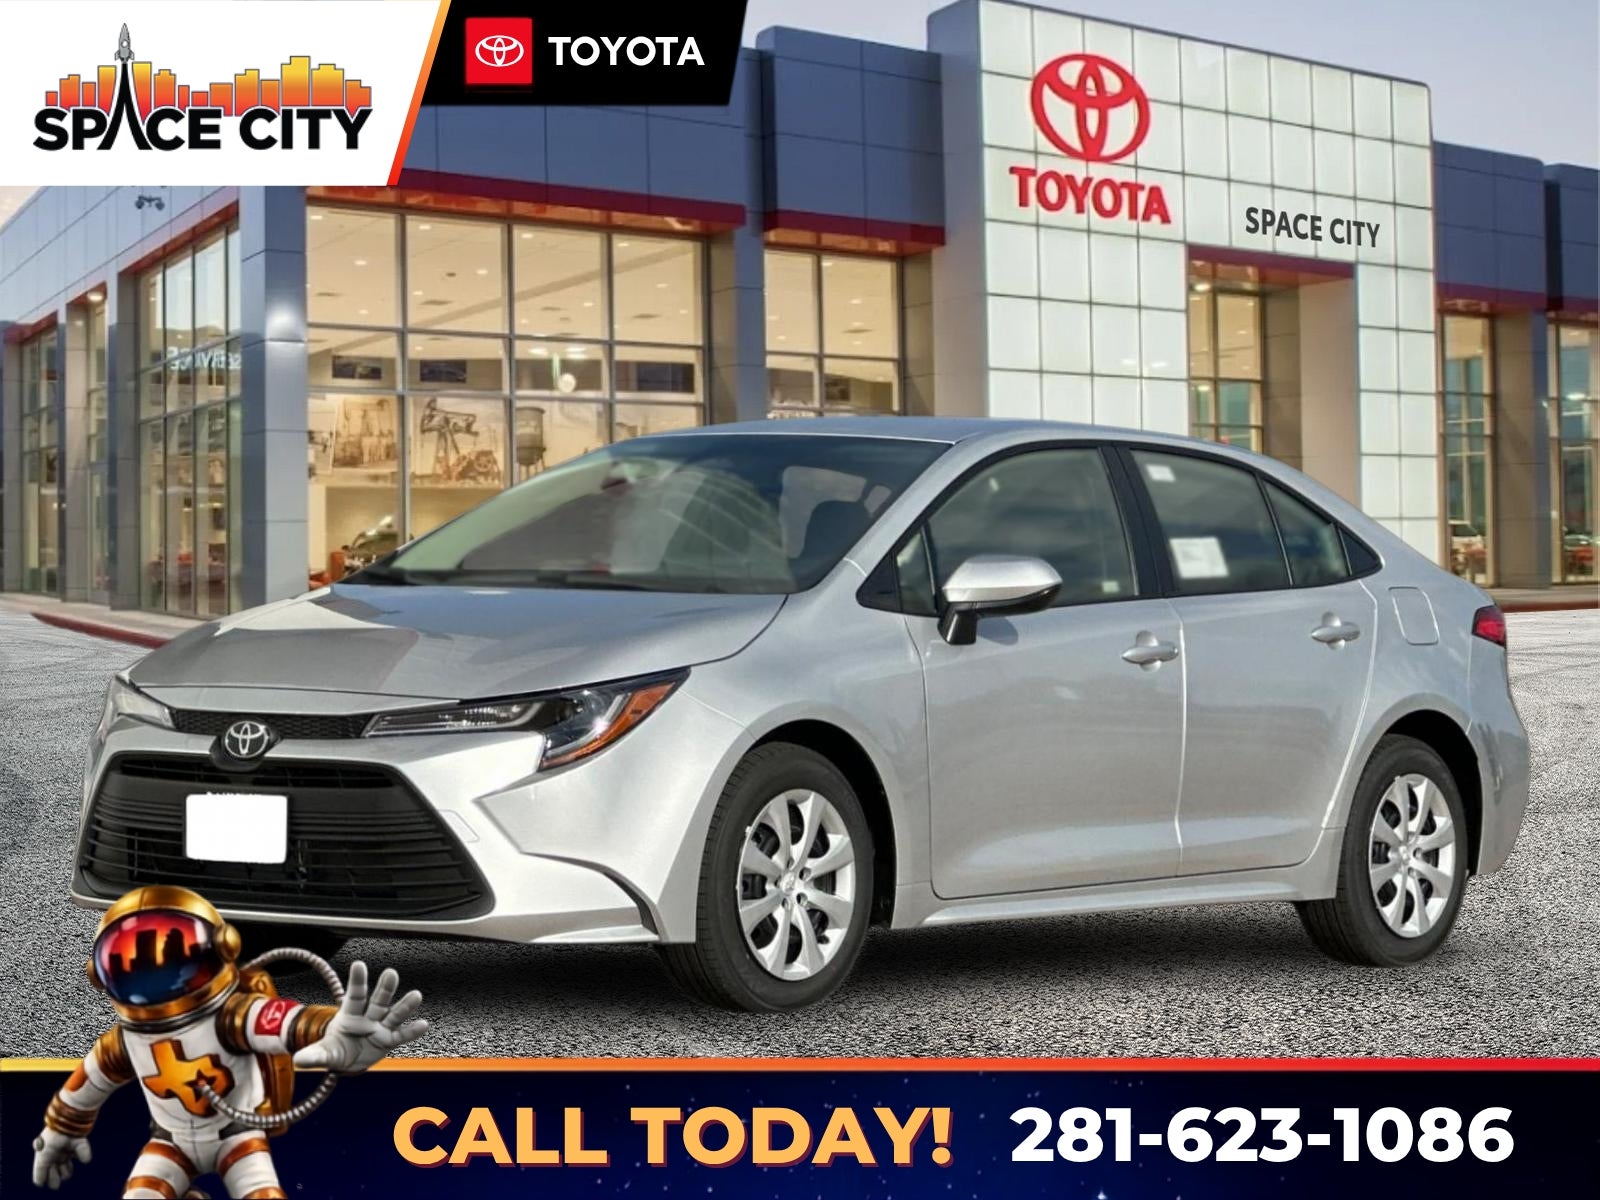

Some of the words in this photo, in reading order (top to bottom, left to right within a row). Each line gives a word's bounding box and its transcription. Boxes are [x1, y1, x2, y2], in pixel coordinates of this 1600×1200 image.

[1009, 166, 1171, 224] TOYOTA
[1245, 206, 1322, 241] SPACE
[1329, 218, 1380, 248] CITY
